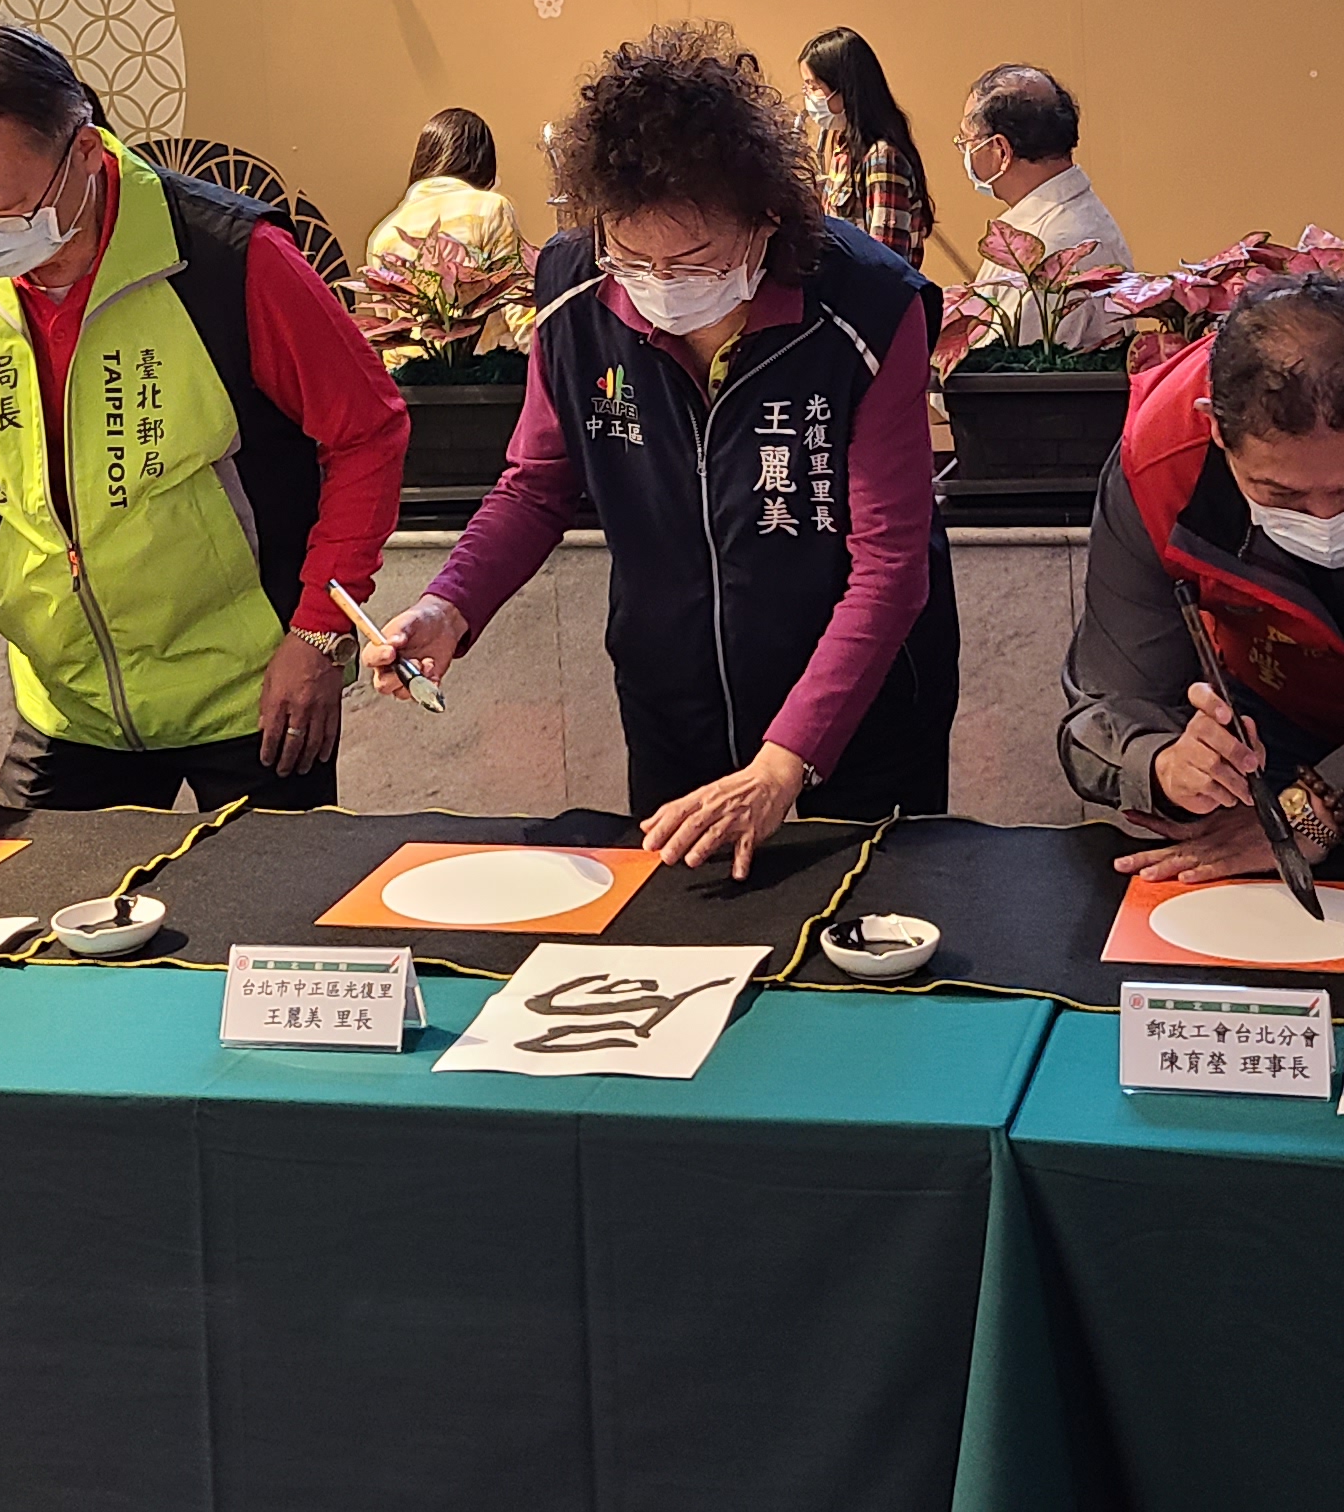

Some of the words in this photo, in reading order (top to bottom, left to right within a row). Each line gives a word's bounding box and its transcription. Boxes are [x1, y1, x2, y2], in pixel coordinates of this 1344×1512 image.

[103, 350, 124, 436] TAIPEI
[135, 349, 164, 479] 臺北郵局
[585, 415, 644, 446] 中正區
[107, 446, 128, 509] POST
[753, 400, 800, 536] 王麗美
[803, 393, 837, 533] 光復里里長
[242, 978, 394, 1000] 台北市中正區光復里
[263, 1006, 323, 1029] 王麗美
[333, 1008, 373, 1031] 里長
[512, 973, 737, 1054] 局
[1145, 1019, 1320, 1048] 郵政工會台北分會
[1159, 1049, 1228, 1075] 陳育瑩
[1239, 1053, 1311, 1080] 理事長
